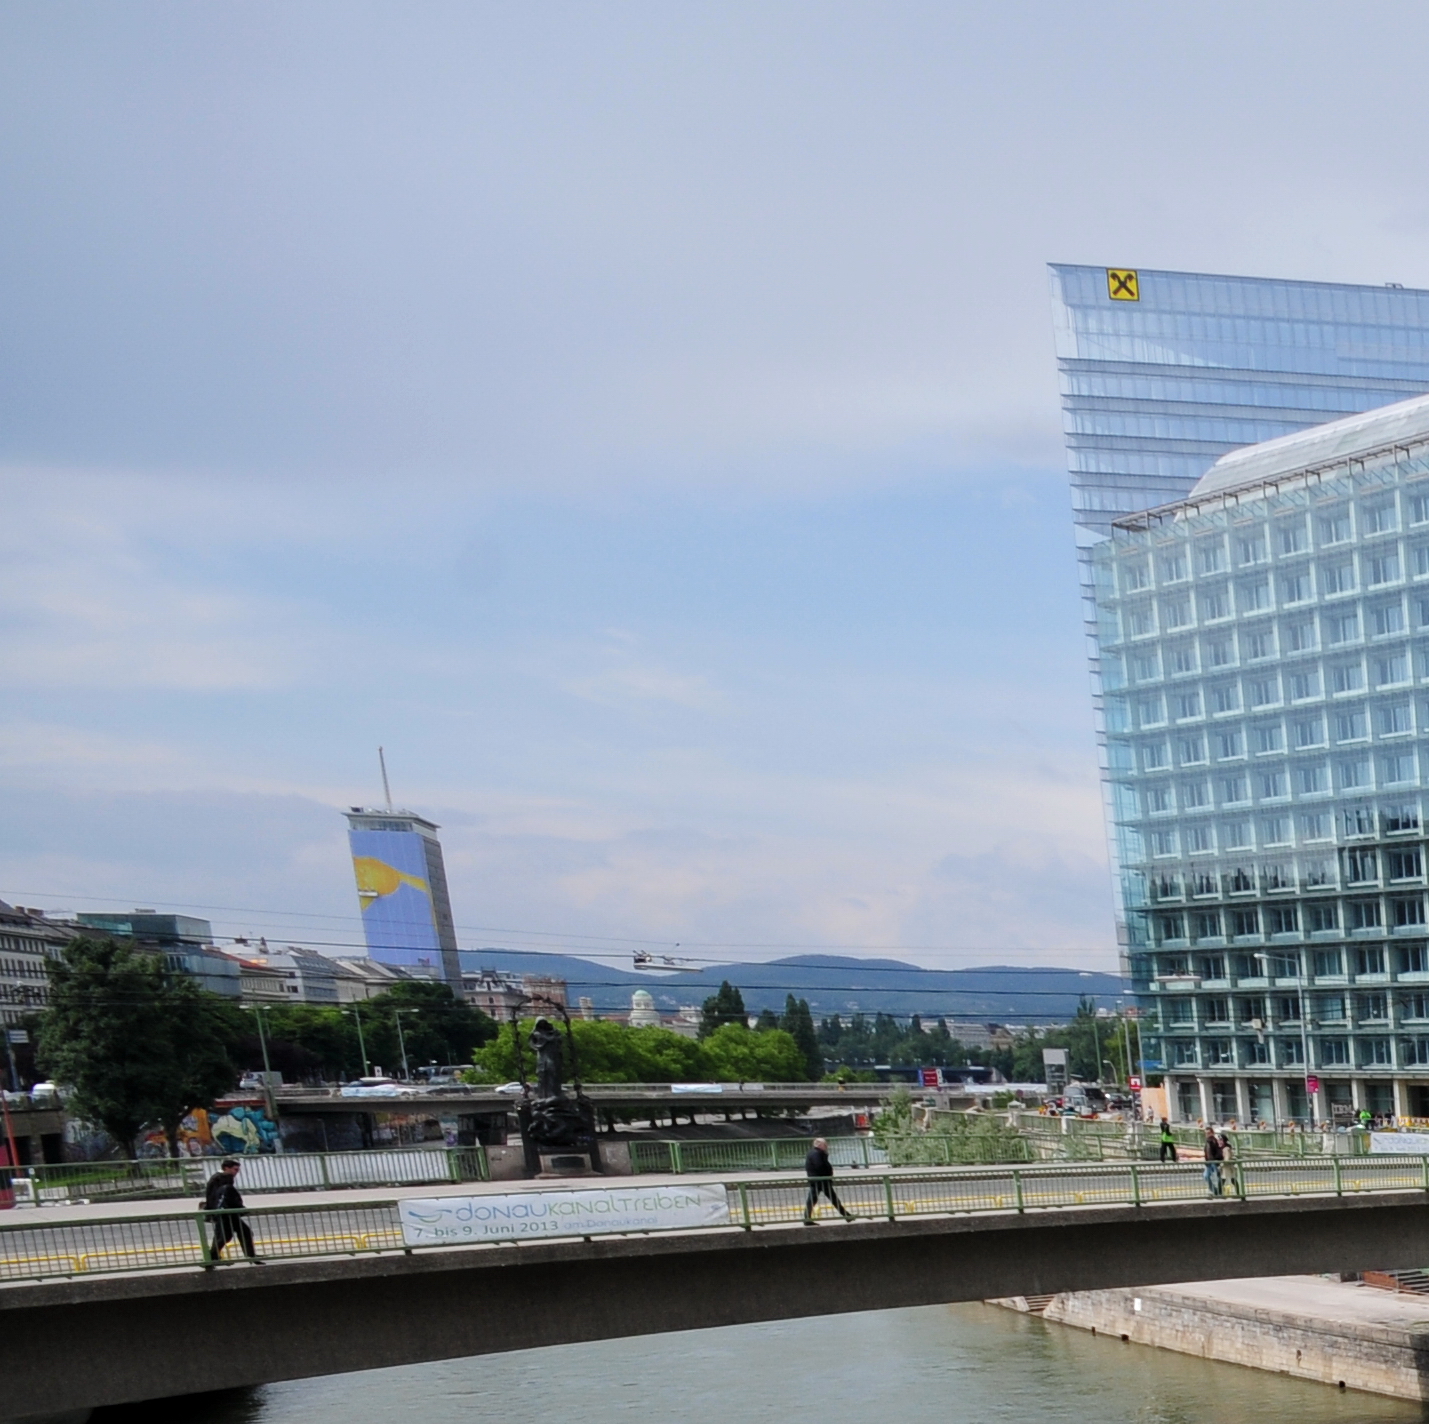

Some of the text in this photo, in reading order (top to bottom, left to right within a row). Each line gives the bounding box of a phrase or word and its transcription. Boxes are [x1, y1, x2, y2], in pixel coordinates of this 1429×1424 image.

[414, 1227, 427, 1239] 7.
[434, 1224, 457, 1237] bis
[463, 1223, 478, 1236] 9.
[483, 1220, 515, 1235] Juni
[519, 1221, 558, 1232] 2013
